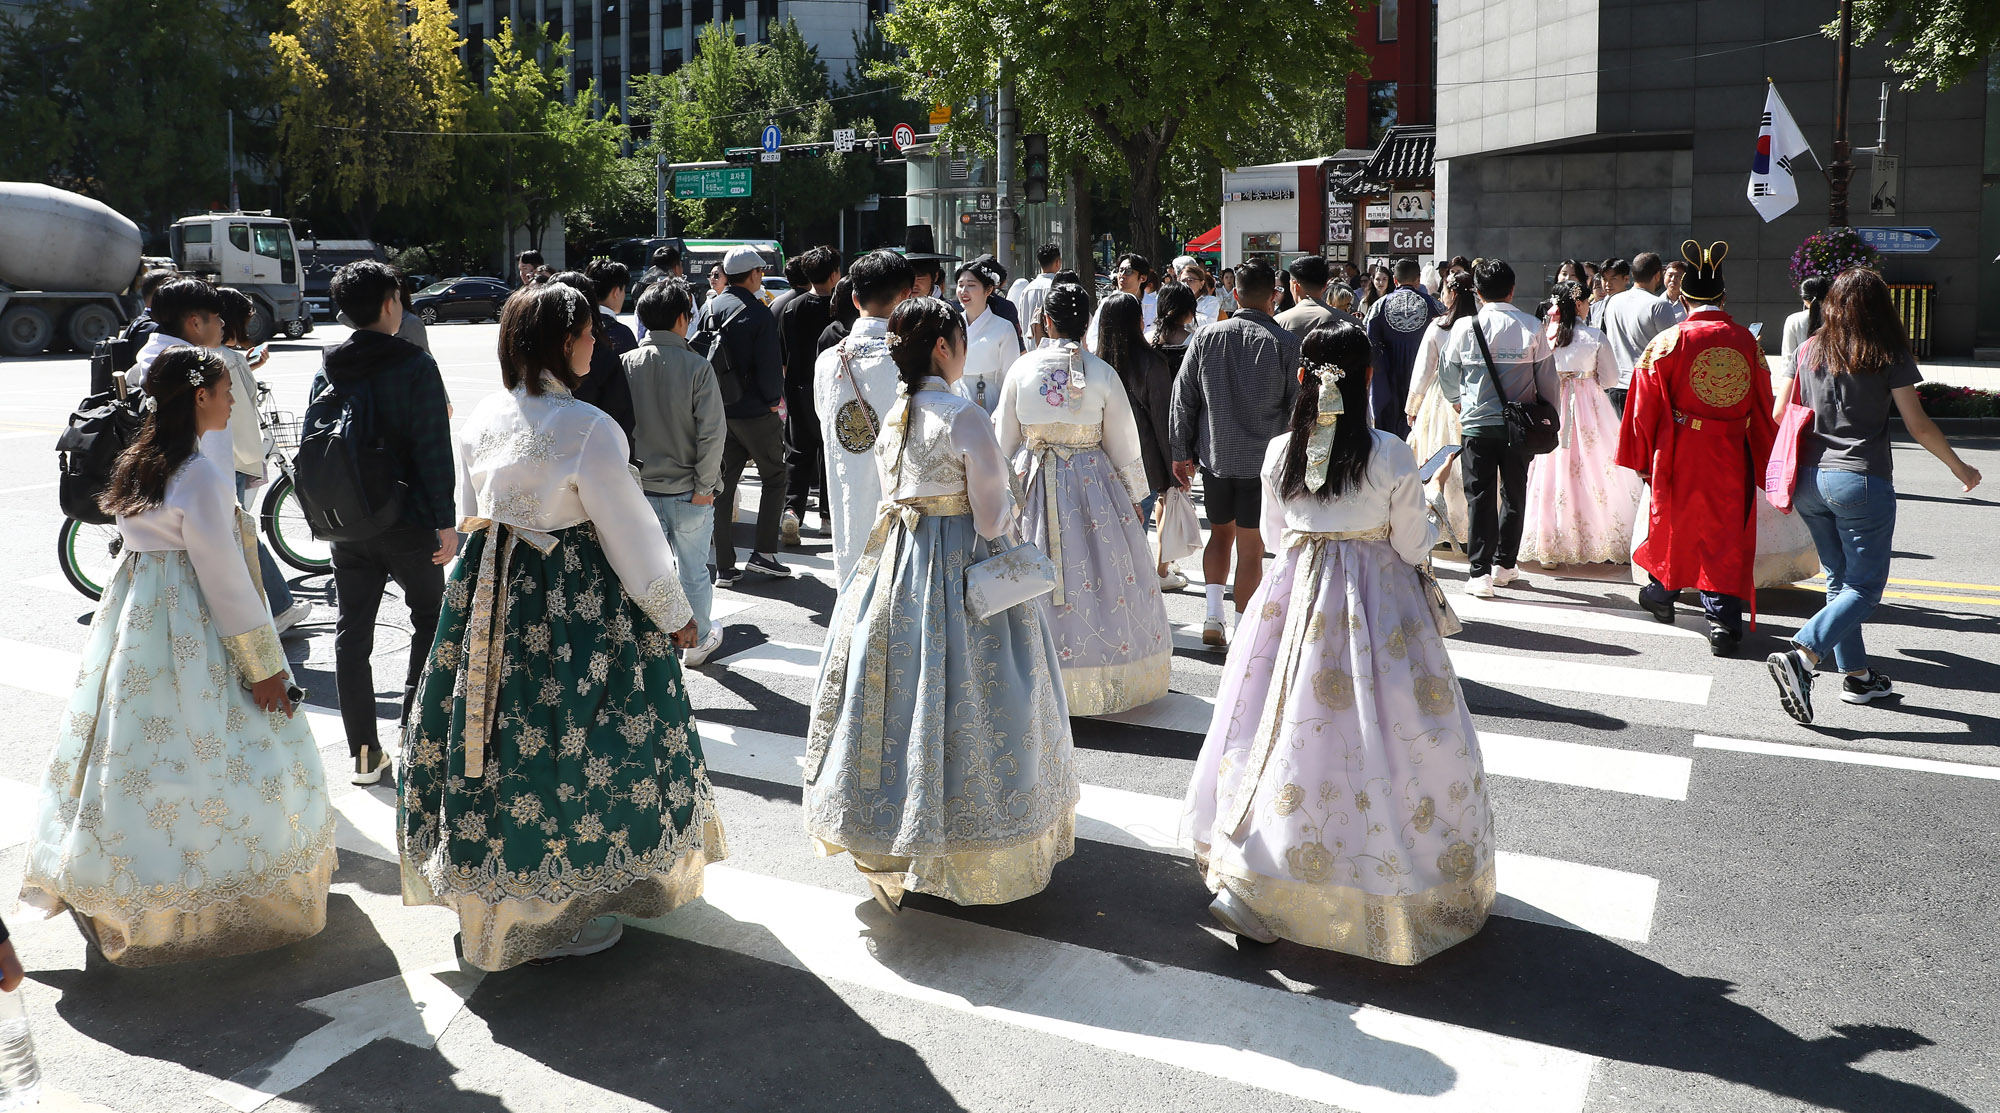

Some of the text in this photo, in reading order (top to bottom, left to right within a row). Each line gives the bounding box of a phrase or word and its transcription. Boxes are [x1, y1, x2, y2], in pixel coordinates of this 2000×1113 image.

[834, 131, 854, 150] 신호준수
[898, 131, 911, 146] 50
[730, 172, 746, 180] 효자동
[978, 213, 993, 221] 경복궁
[1393, 231, 1433, 249] Cafe
[1864, 231, 1926, 242] 통의파출소
